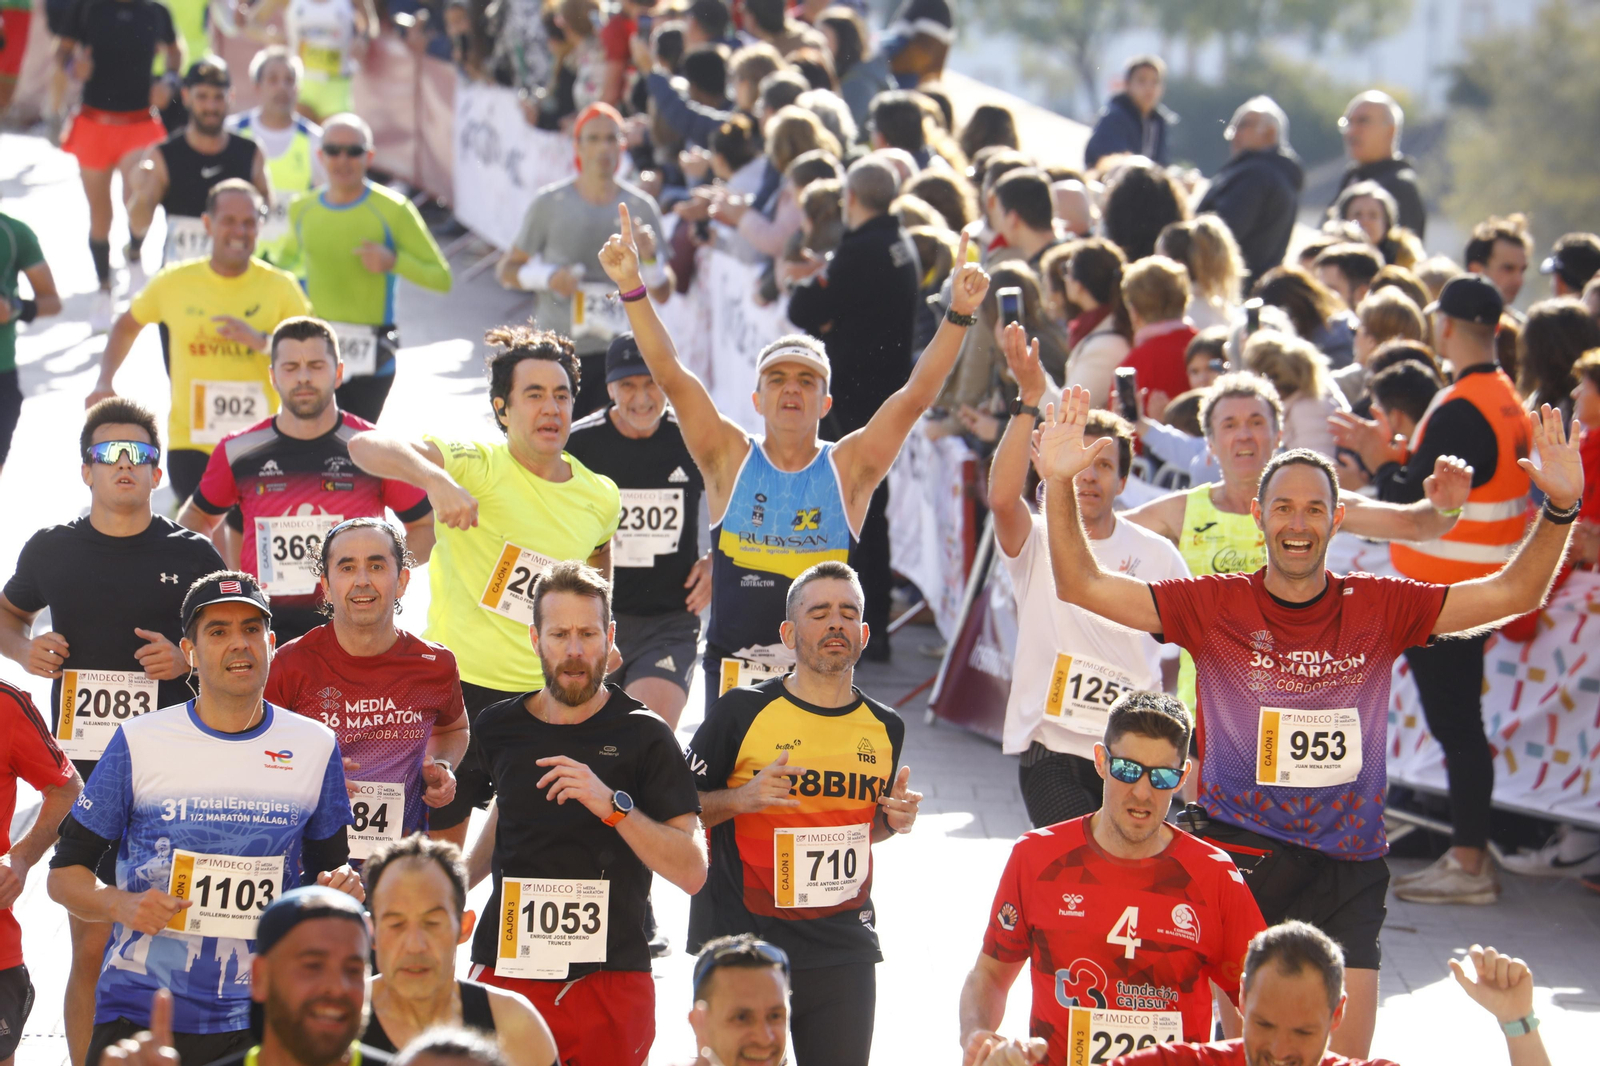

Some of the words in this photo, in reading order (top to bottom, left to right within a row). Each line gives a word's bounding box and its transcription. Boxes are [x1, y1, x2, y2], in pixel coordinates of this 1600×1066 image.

[214, 397, 255, 416] 902
[618, 506, 678, 531] 2302
[739, 531, 830, 548] RUBYSAN
[492, 567, 508, 594] CAJÓN
[1250, 651, 1274, 669] 36
[1280, 653, 1365, 678] MARATÓN
[87, 673, 125, 682] IMDECO
[1070, 673, 1134, 706] 125
[64, 696, 73, 725] CAJÓN
[76, 688, 150, 719] 2083
[345, 697, 396, 713] MEDIA
[320, 712, 340, 728] 36
[346, 706, 422, 729] MARATÓN
[1293, 715, 1332, 723] IMDECO
[345, 730, 399, 744] CÓRDOBA
[403, 729, 425, 739] 2022
[1290, 730, 1347, 761] 953
[857, 753, 876, 764] TR8
[1264, 736, 1273, 767] CAJÓN
[161, 798, 187, 821] 31
[192, 797, 290, 814] TotalEnergies
[290, 802, 299, 826] 2022
[190, 814, 204, 822] 1/2
[206, 812, 251, 822] MARATÓN
[252, 814, 288, 825] MÁLAGA
[351, 802, 388, 833] 84
[807, 832, 845, 843] IMDECO
[209, 859, 252, 871] IMDECO
[806, 848, 857, 881] 710
[195, 875, 274, 911] 1103
[533, 884, 573, 894] IMDECO
[199, 911, 230, 919] GUILLERMO
[522, 900, 601, 935] 1053
[1059, 908, 1085, 917] hummel
[506, 909, 514, 941] CAJÓN
[1106, 906, 1142, 959] 4
[1117, 981, 1178, 1001] fundación
[1117, 995, 1169, 1010] cajasur
[1106, 1013, 1150, 1025] IMDECO
[1075, 1039, 1085, 1066] AJÓN
